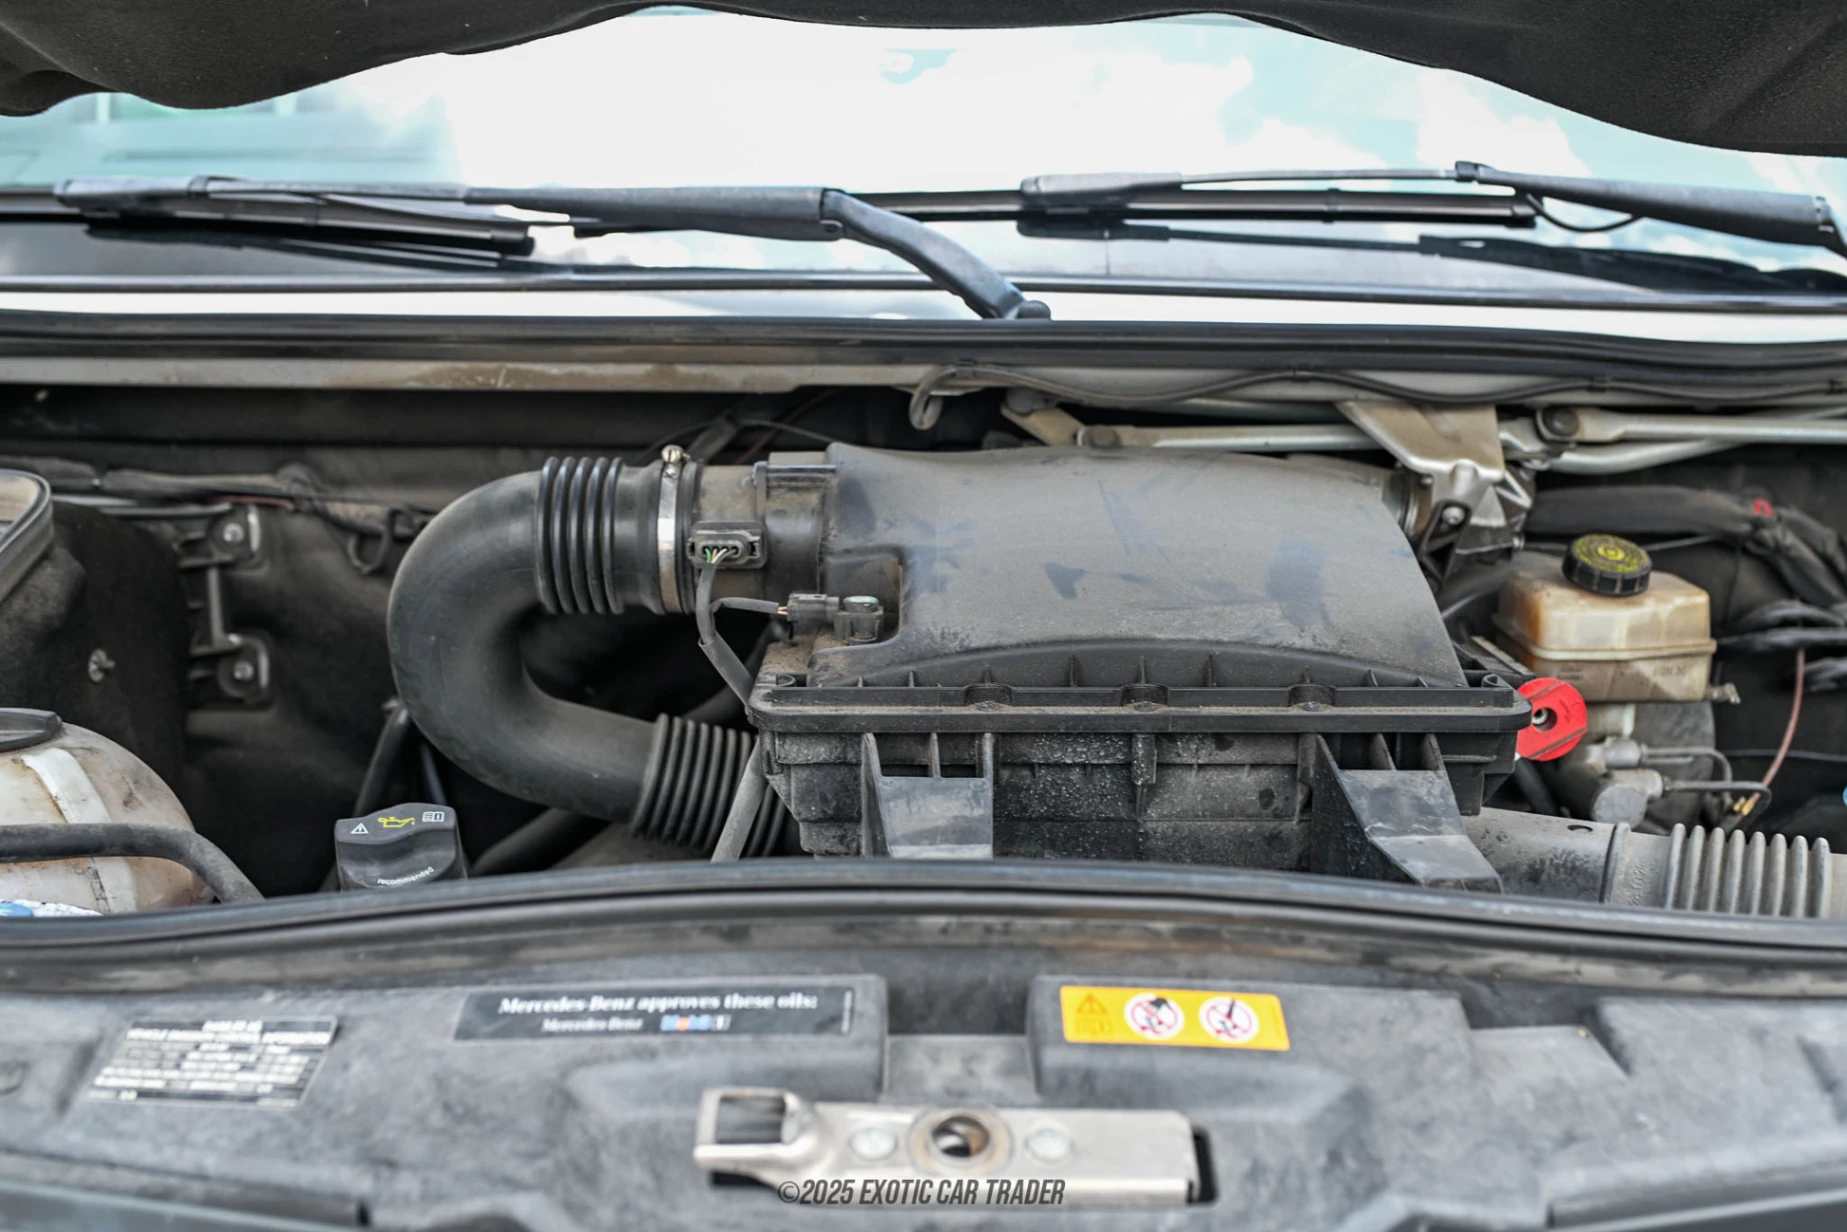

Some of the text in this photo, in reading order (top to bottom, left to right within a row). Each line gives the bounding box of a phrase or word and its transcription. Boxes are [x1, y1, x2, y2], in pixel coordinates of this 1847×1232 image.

[377, 866, 434, 885] recommended
[637, 996, 721, 1013] approves
[724, 992, 775, 1010] these
